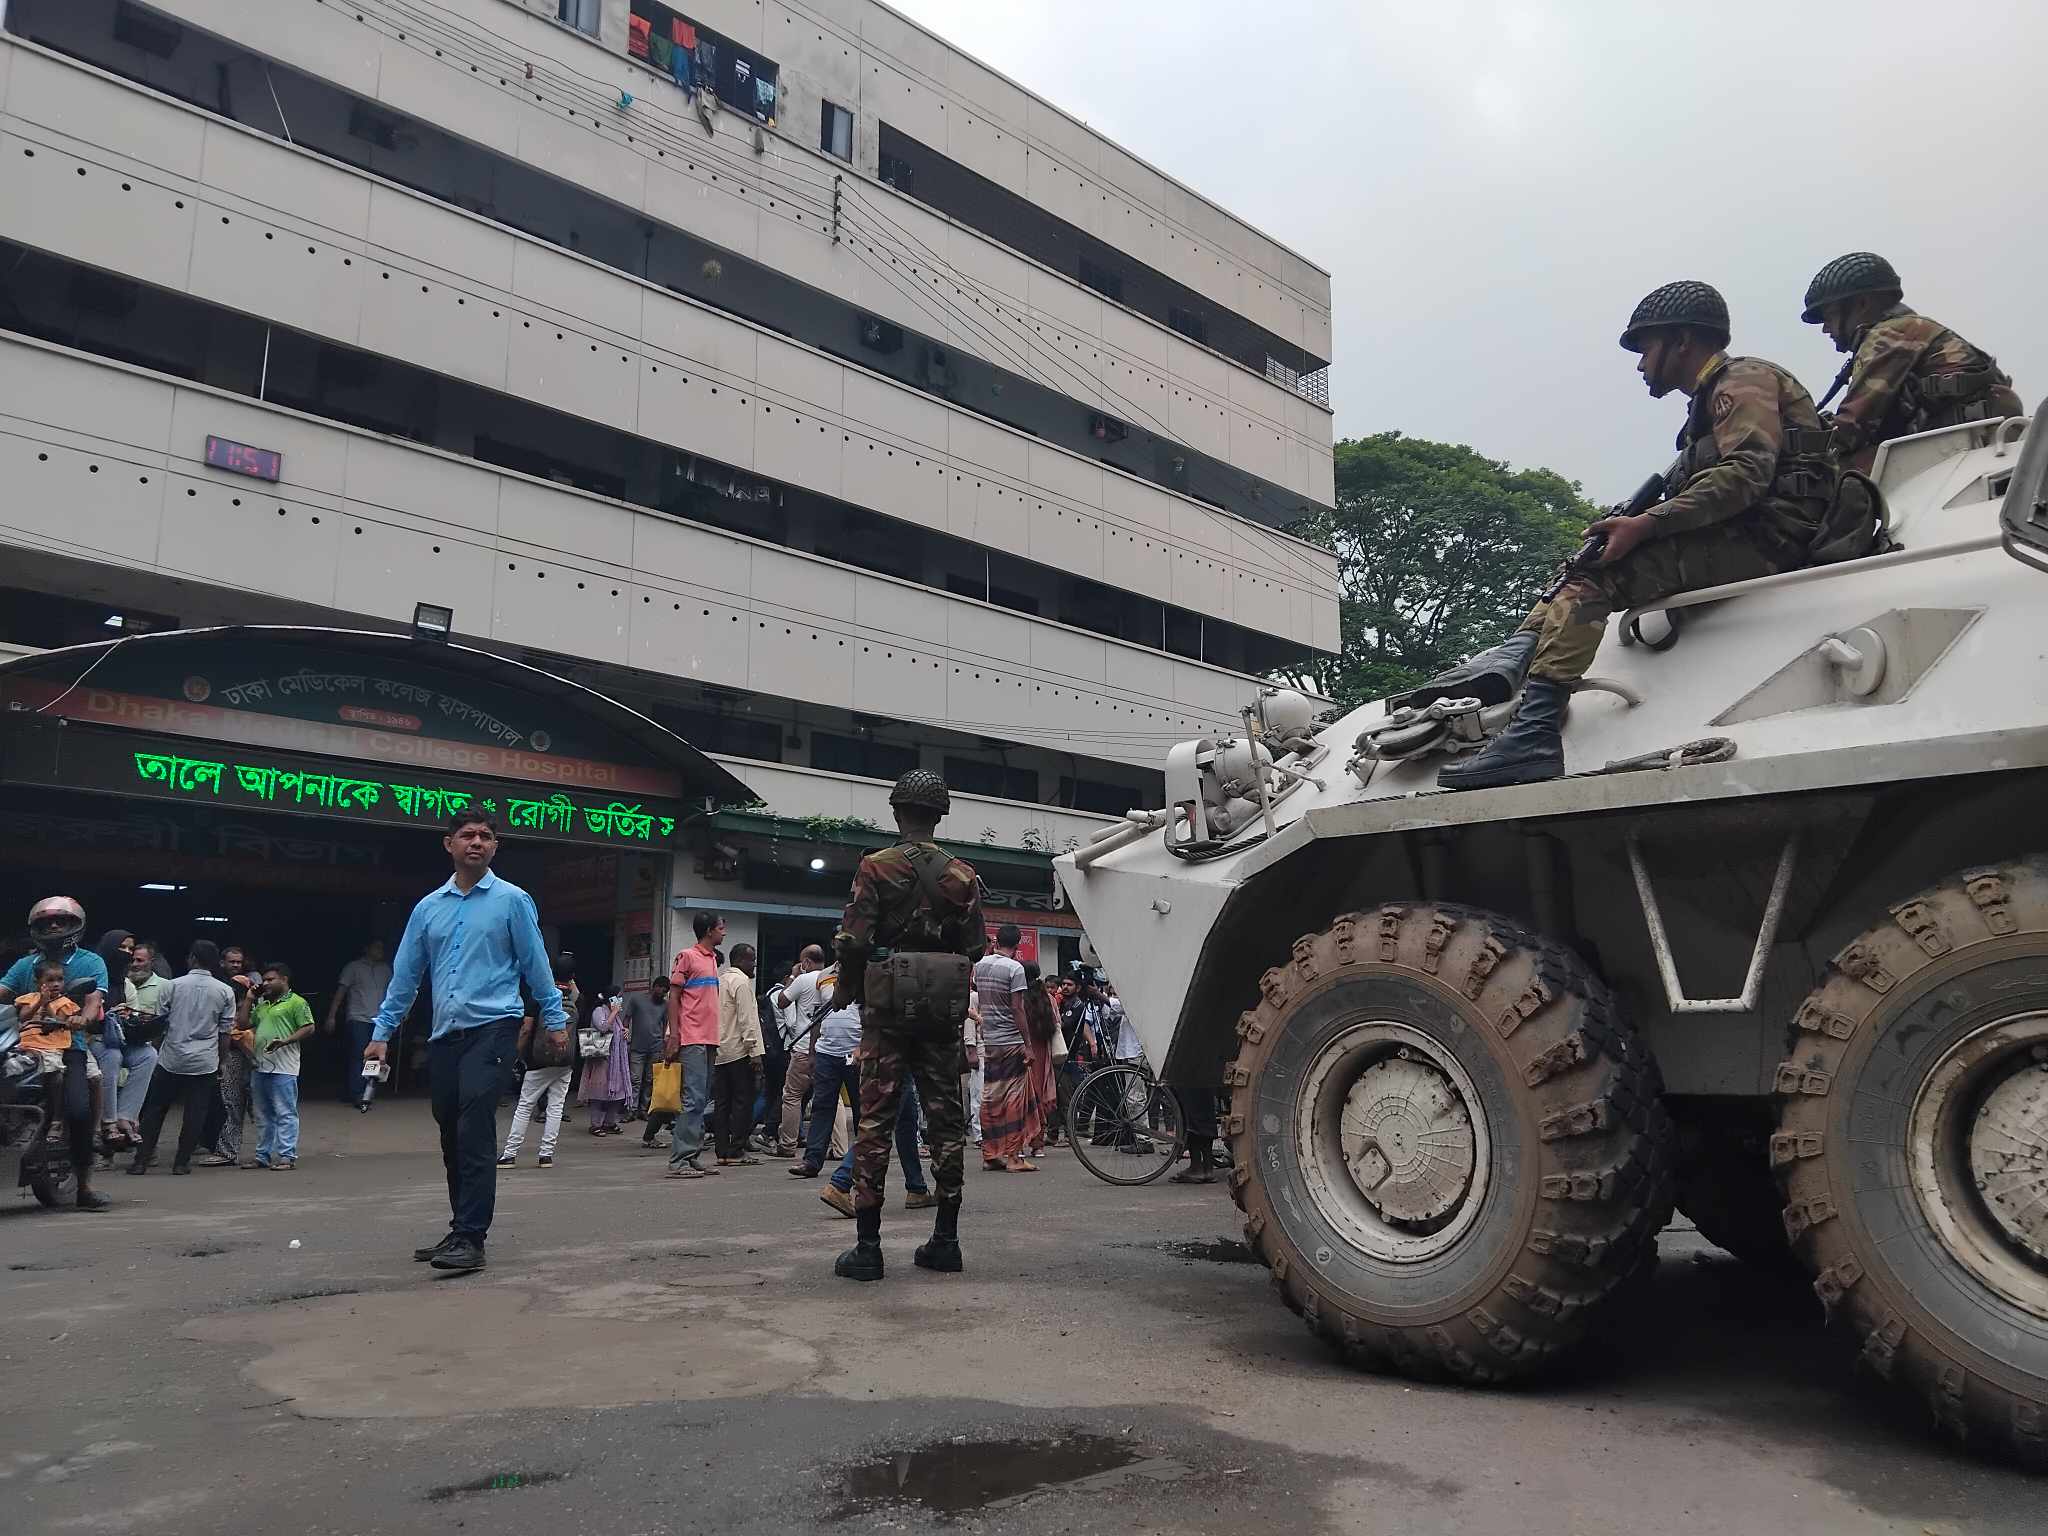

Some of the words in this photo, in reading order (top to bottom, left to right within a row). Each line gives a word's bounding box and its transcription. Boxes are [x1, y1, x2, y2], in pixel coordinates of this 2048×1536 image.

[87, 692, 209, 729] Dhaka
[369, 733, 490, 767] College
[501, 751, 616, 782] Hospital
[220, 678, 273, 704] ঢাকা
[278, 667, 368, 694] মেডিকেল
[373, 678, 435, 708] কলেজ
[438, 693, 524, 747] হাসপাতাল
[234, 766, 384, 811] আপনাকে
[507, 793, 577, 833] রোগী
[583, 802, 656, 841] ভর্তির
